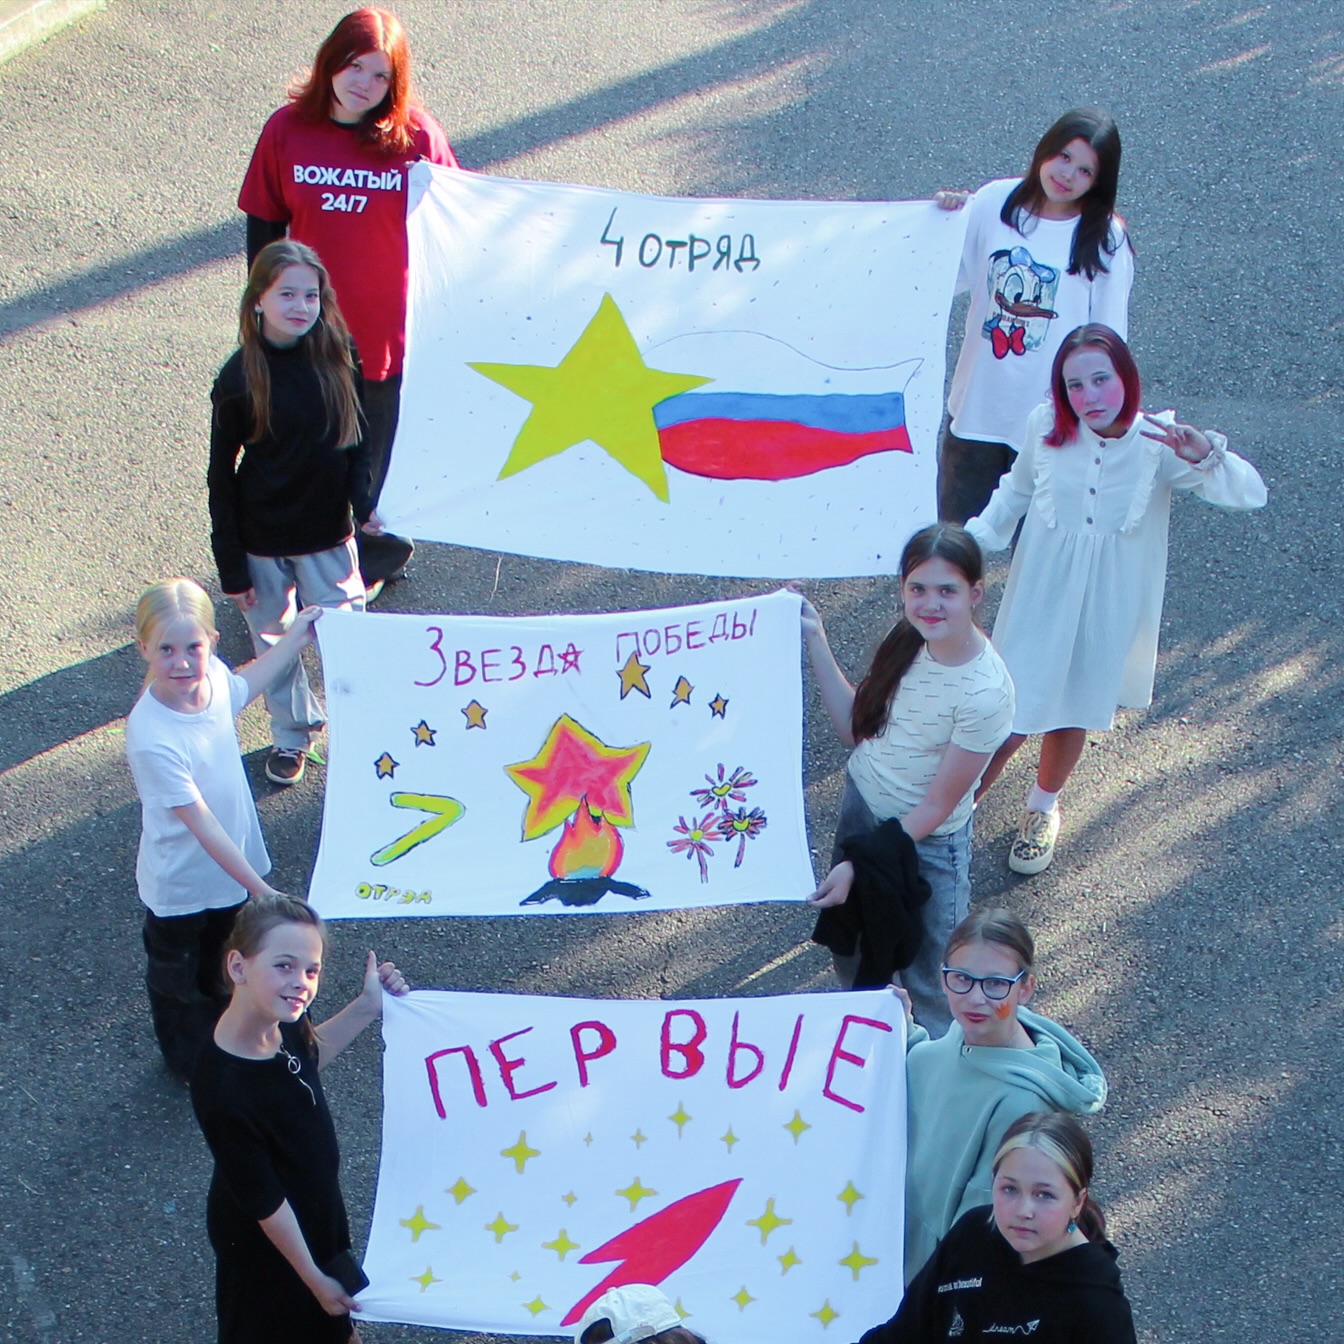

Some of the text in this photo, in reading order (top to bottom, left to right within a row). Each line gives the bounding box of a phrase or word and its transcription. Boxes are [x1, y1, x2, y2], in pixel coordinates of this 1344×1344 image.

[293, 165, 402, 191] ВОЖАТЫЙ
[321, 192, 368, 213] 24/7
[600, 206, 624, 267] 4
[615, 608, 758, 663] ПОБЕДЫ
[369, 791, 466, 867] 7
[425, 1008, 893, 1120] ПЕРВЫЕ
